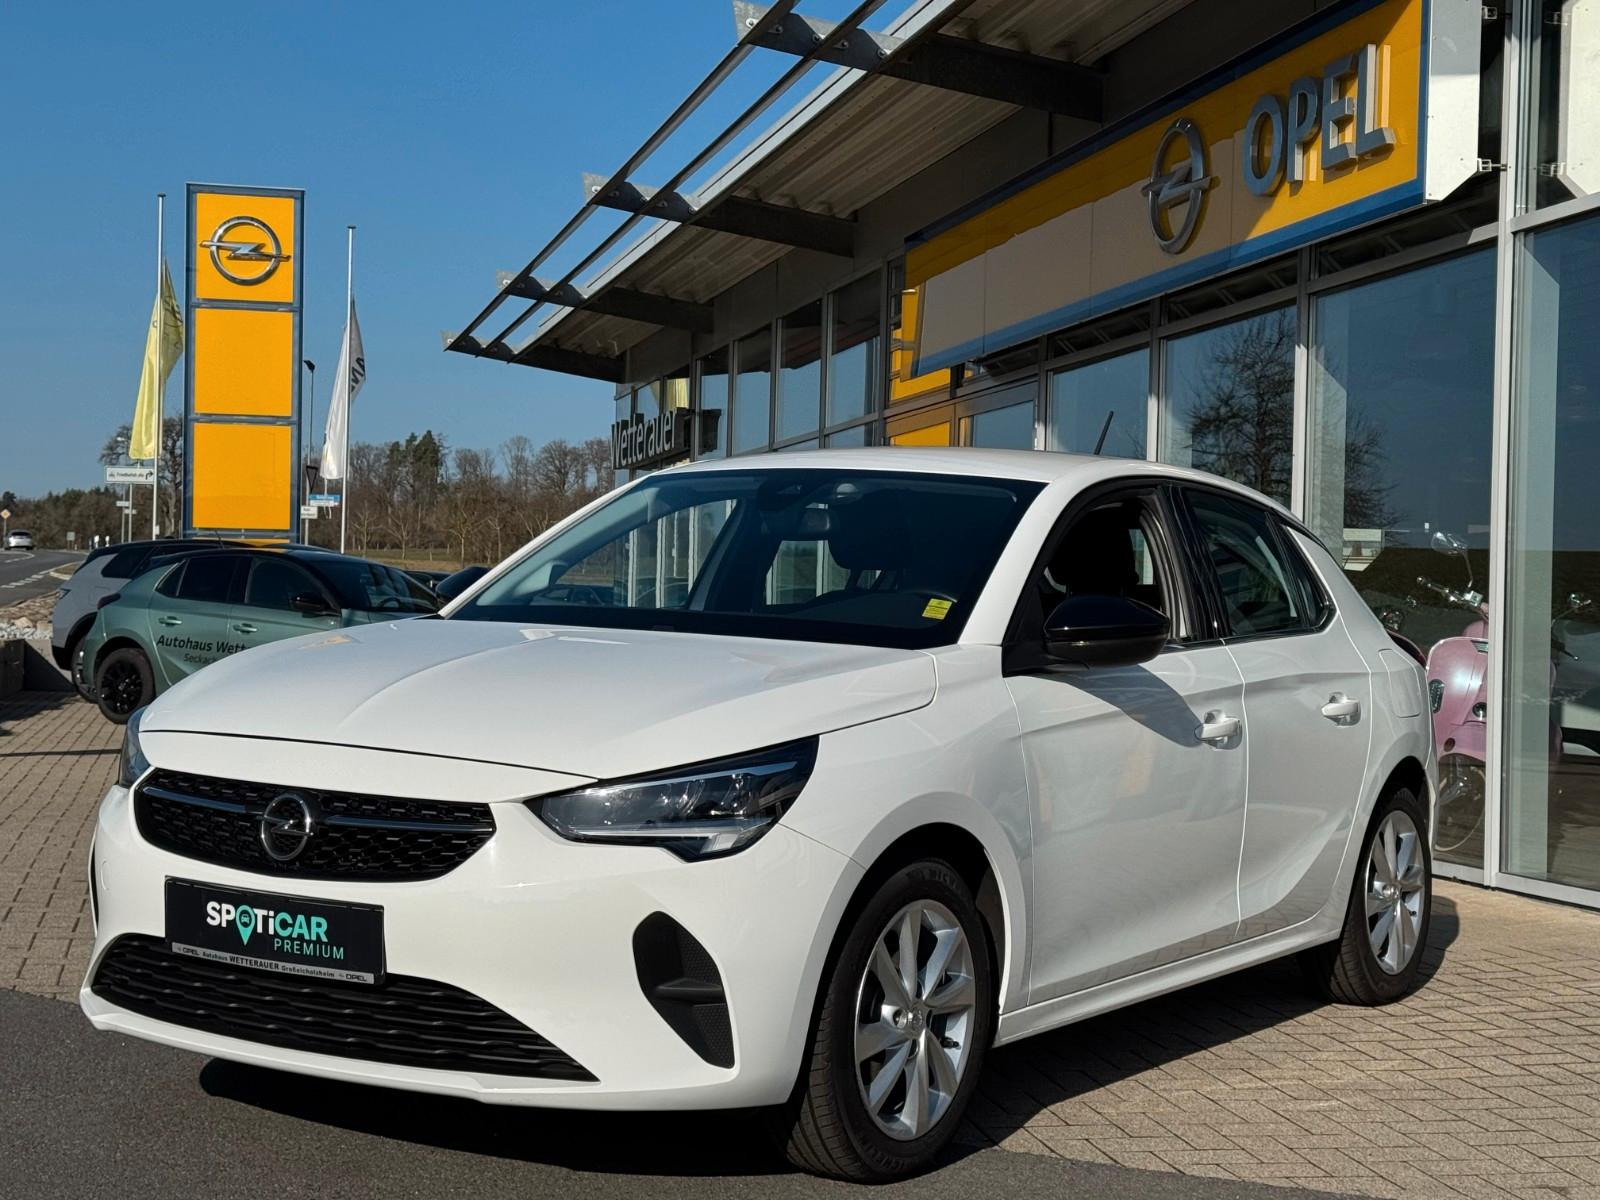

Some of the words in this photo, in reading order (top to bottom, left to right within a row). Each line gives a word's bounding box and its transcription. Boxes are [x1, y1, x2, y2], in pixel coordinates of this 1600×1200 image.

[1243, 43, 1396, 197] OPEL
[611, 408, 677, 470] Wetterauer
[157, 635, 213, 652] Autohaus
[217, 640, 250, 654] Wett
[182, 947, 200, 956] OPEL
[203, 951, 228, 962] Autohaus
[229, 955, 280, 971] WETTERAUER
[345, 973, 367, 982] OPEL
[274, 937, 345, 960] PREMIUM
